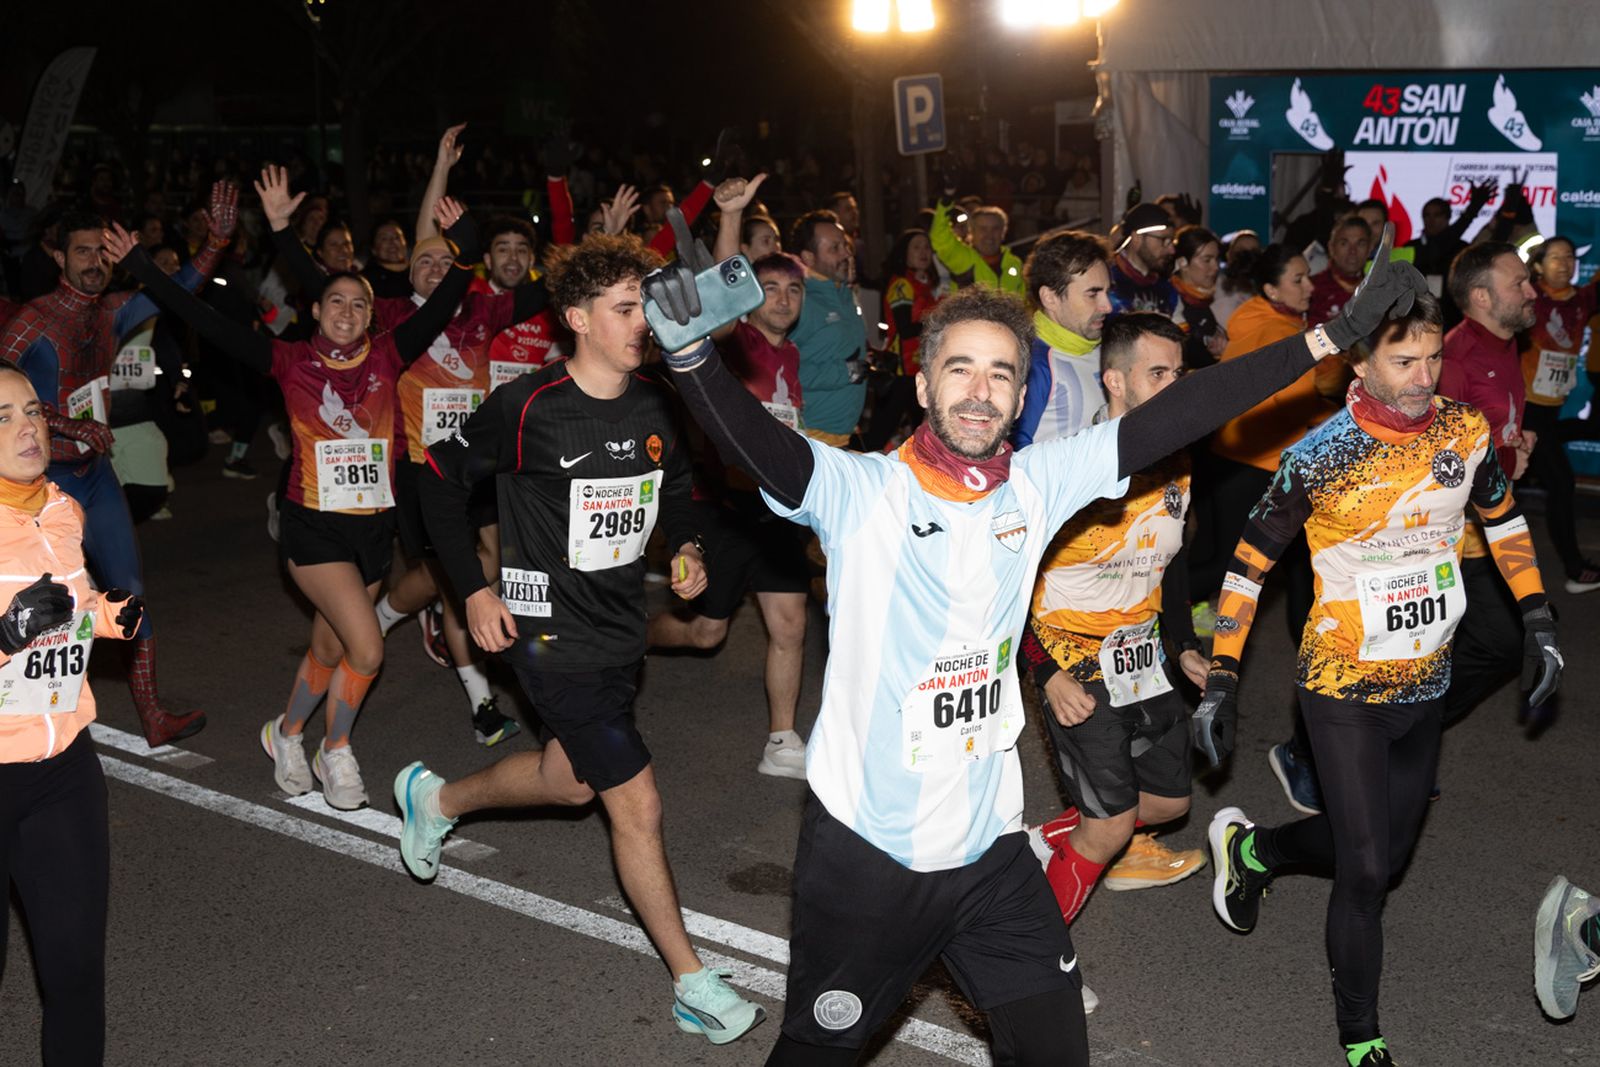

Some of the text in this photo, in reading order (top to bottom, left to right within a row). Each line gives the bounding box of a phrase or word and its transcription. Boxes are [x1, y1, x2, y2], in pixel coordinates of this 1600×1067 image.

[906, 84, 935, 145] P
[1352, 109, 1460, 145] ANTÓN
[442, 353, 459, 370] 43
[333, 414, 352, 432] 43
[333, 464, 379, 485] 3815
[595, 487, 634, 498] NOCHE DE
[582, 500, 602, 511] SAN
[589, 507, 645, 539] 2989
[1361, 552, 1393, 561] sando
[1417, 573, 1428, 584] DE
[1386, 593, 1447, 632] 6301
[1409, 628, 1426, 638] David
[24, 644, 84, 680] 6413
[934, 657, 973, 673] NOCHE
[974, 653, 989, 667] DE
[1113, 642, 1153, 675] 6300
[918, 667, 989, 691] SAN ANTÓN
[933, 678, 1001, 728] 6410
[960, 724, 982, 736] Carlos
